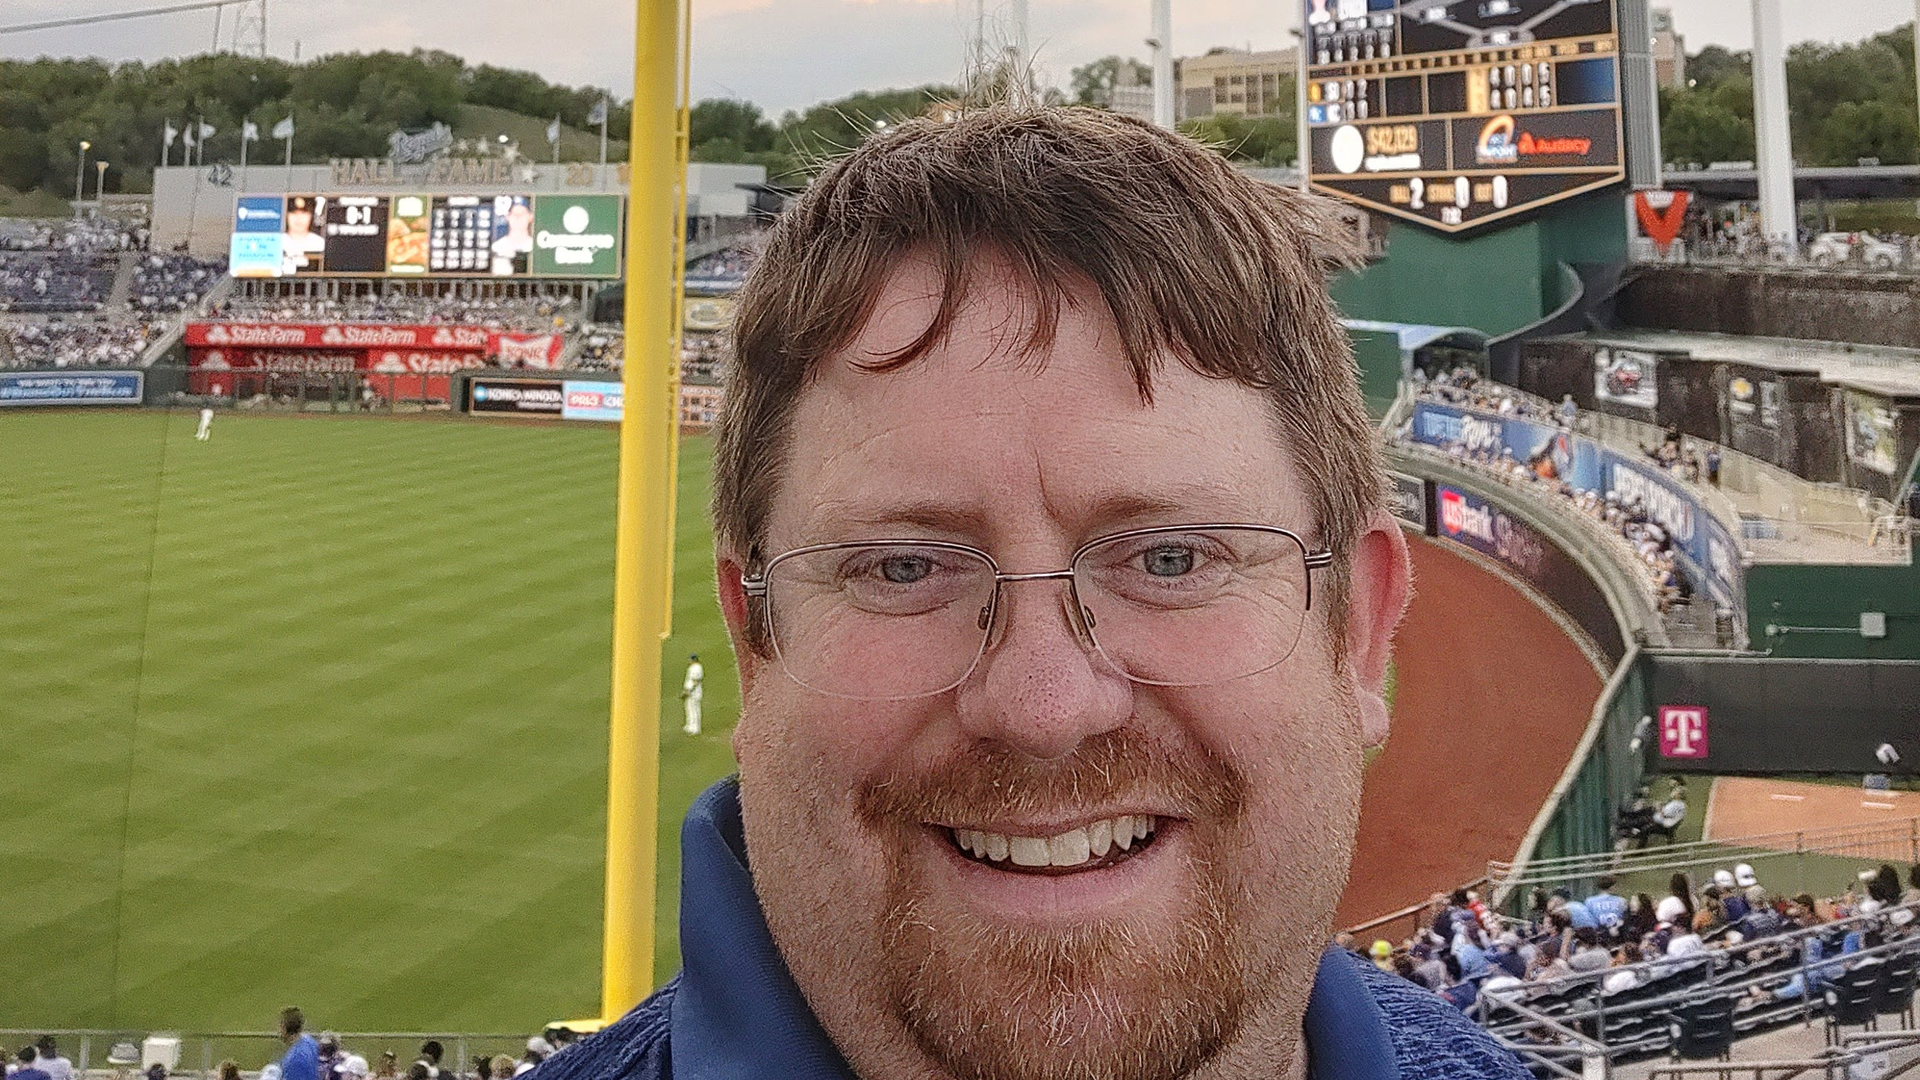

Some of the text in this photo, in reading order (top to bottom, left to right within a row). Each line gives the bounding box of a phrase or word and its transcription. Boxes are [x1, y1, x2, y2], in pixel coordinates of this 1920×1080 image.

[207, 163, 232, 187] 42
[329, 157, 403, 187] HALL
[424, 156, 514, 187] FAME
[1410, 177, 1424, 210] 2
[1455, 176, 1470, 209] 0
[1493, 175, 1508, 209] 0
[487, 387, 563, 403] KONICA MINOLTA
